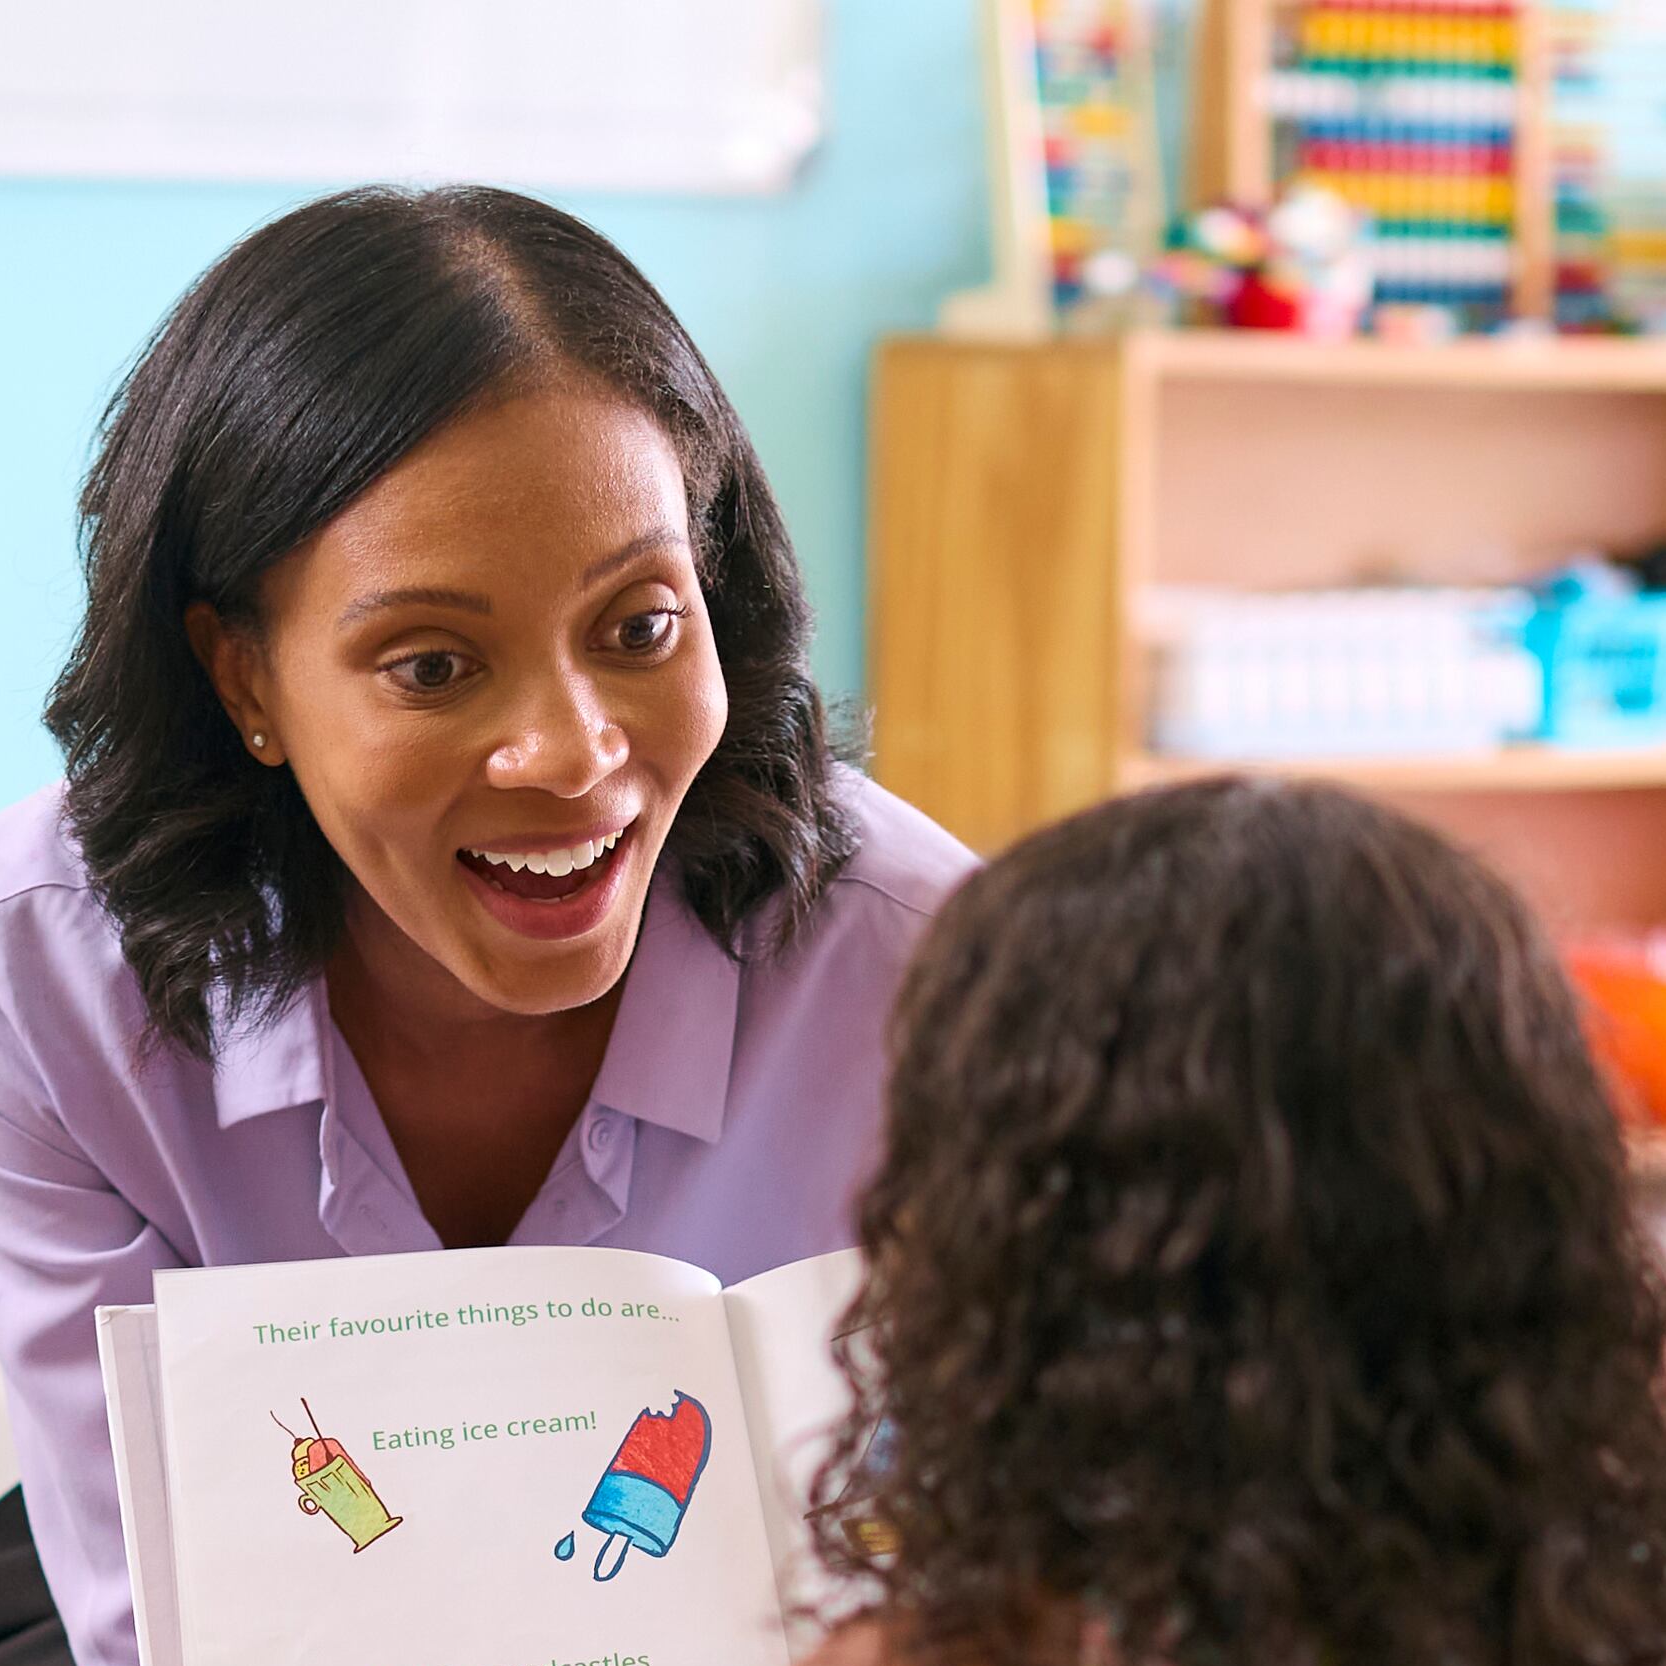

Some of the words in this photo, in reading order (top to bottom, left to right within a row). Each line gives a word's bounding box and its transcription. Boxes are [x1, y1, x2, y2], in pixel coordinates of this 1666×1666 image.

[253, 1320, 321, 1344] Their
[329, 1309, 449, 1338] favourite
[457, 1302, 539, 1327] things
[547, 1299, 573, 1319] to
[581, 1296, 613, 1318] do
[621, 1300, 681, 1323] are...
[372, 1426, 455, 1450] Eating
[462, 1421, 498, 1442] ice
[507, 1410, 597, 1437] cream!
